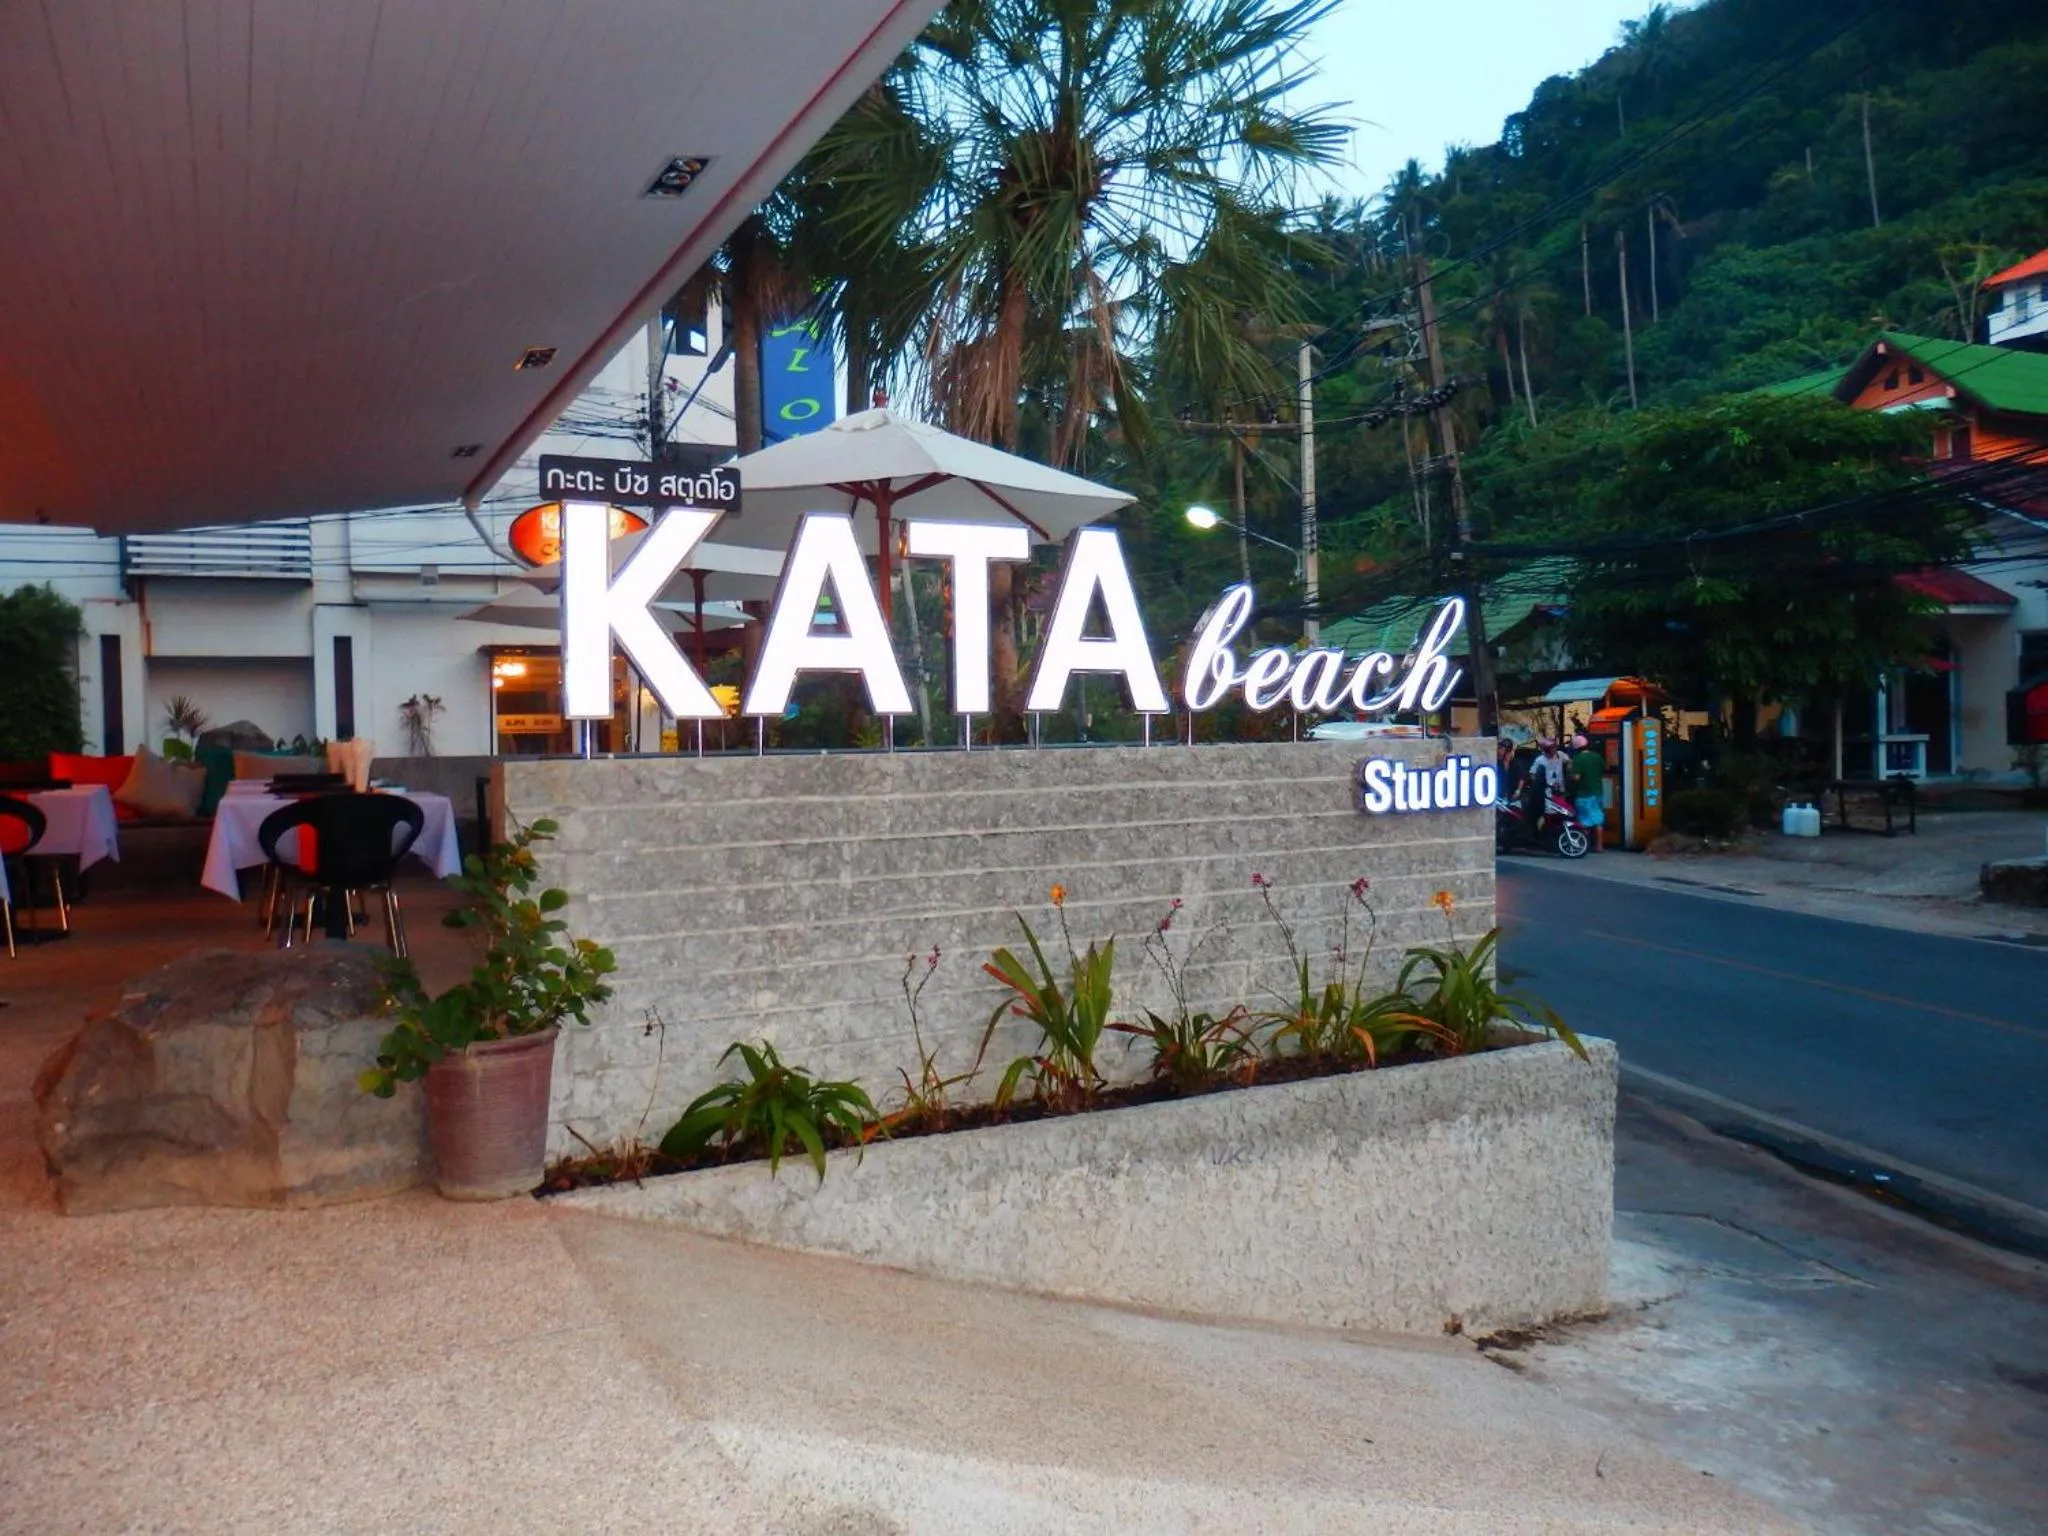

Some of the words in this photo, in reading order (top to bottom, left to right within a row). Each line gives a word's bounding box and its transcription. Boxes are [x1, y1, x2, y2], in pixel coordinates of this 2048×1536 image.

[547, 467, 605, 492] กะตะ
[615, 466, 650, 496] บีช
[660, 468, 736, 505] สตูดิโอ
[563, 500, 1170, 718] KATA
[1184, 583, 1466, 714] beach
[1363, 756, 1497, 814] Studio
